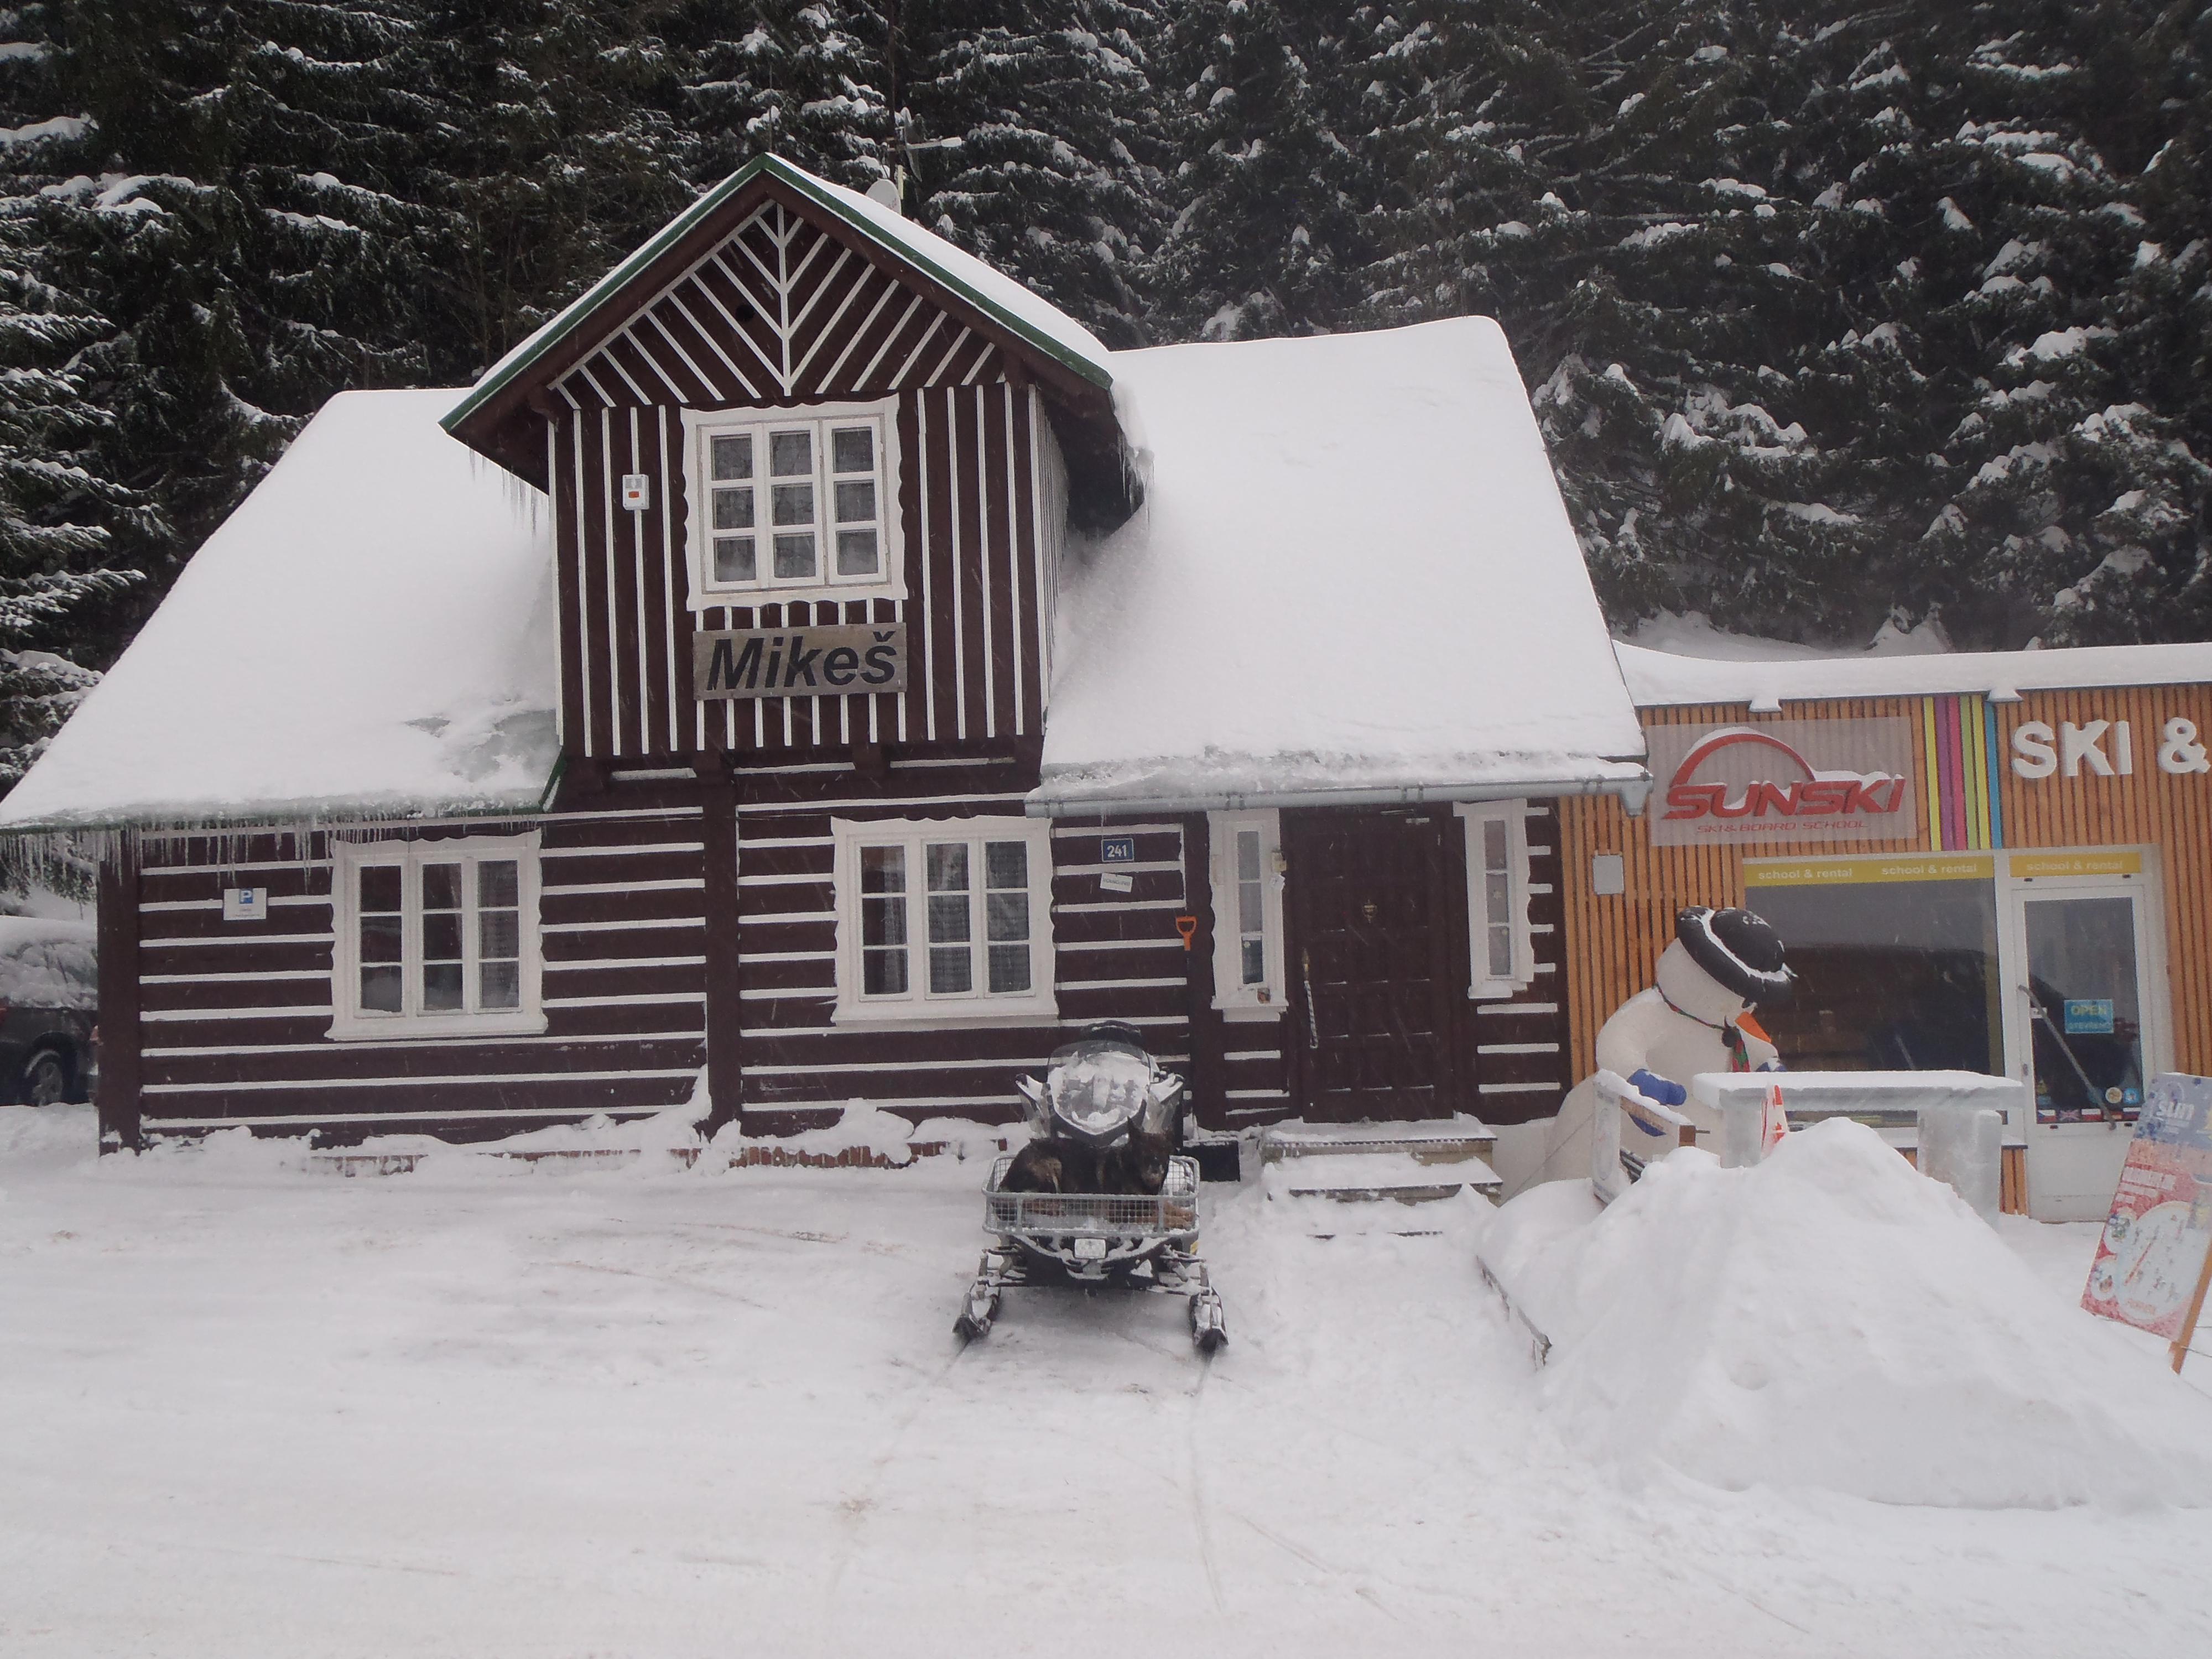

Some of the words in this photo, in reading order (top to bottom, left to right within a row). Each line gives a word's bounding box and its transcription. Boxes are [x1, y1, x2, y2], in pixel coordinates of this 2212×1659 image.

[707, 630, 897, 691] Mikeš
[2011, 719, 2133, 779] SKI
[2158, 717, 2211, 774] &
[1662, 777, 1906, 820] SUNSKI
[1802, 820, 1868, 830] SCHOOL
[1107, 844, 1127, 858] 241
[1882, 864, 1924, 875] school
[1928, 864, 1937, 874] &
[1942, 863, 1977, 873] rental
[2026, 861, 2069, 871] school
[2074, 860, 2082, 870] &
[2086, 860, 2123, 870] rental
[1758, 869, 1800, 880] school
[1804, 869, 1813, 878] &
[1817, 868, 1852, 878] rental
[241, 890, 253, 902] P
[2070, 1005, 2107, 1016] OPEN
